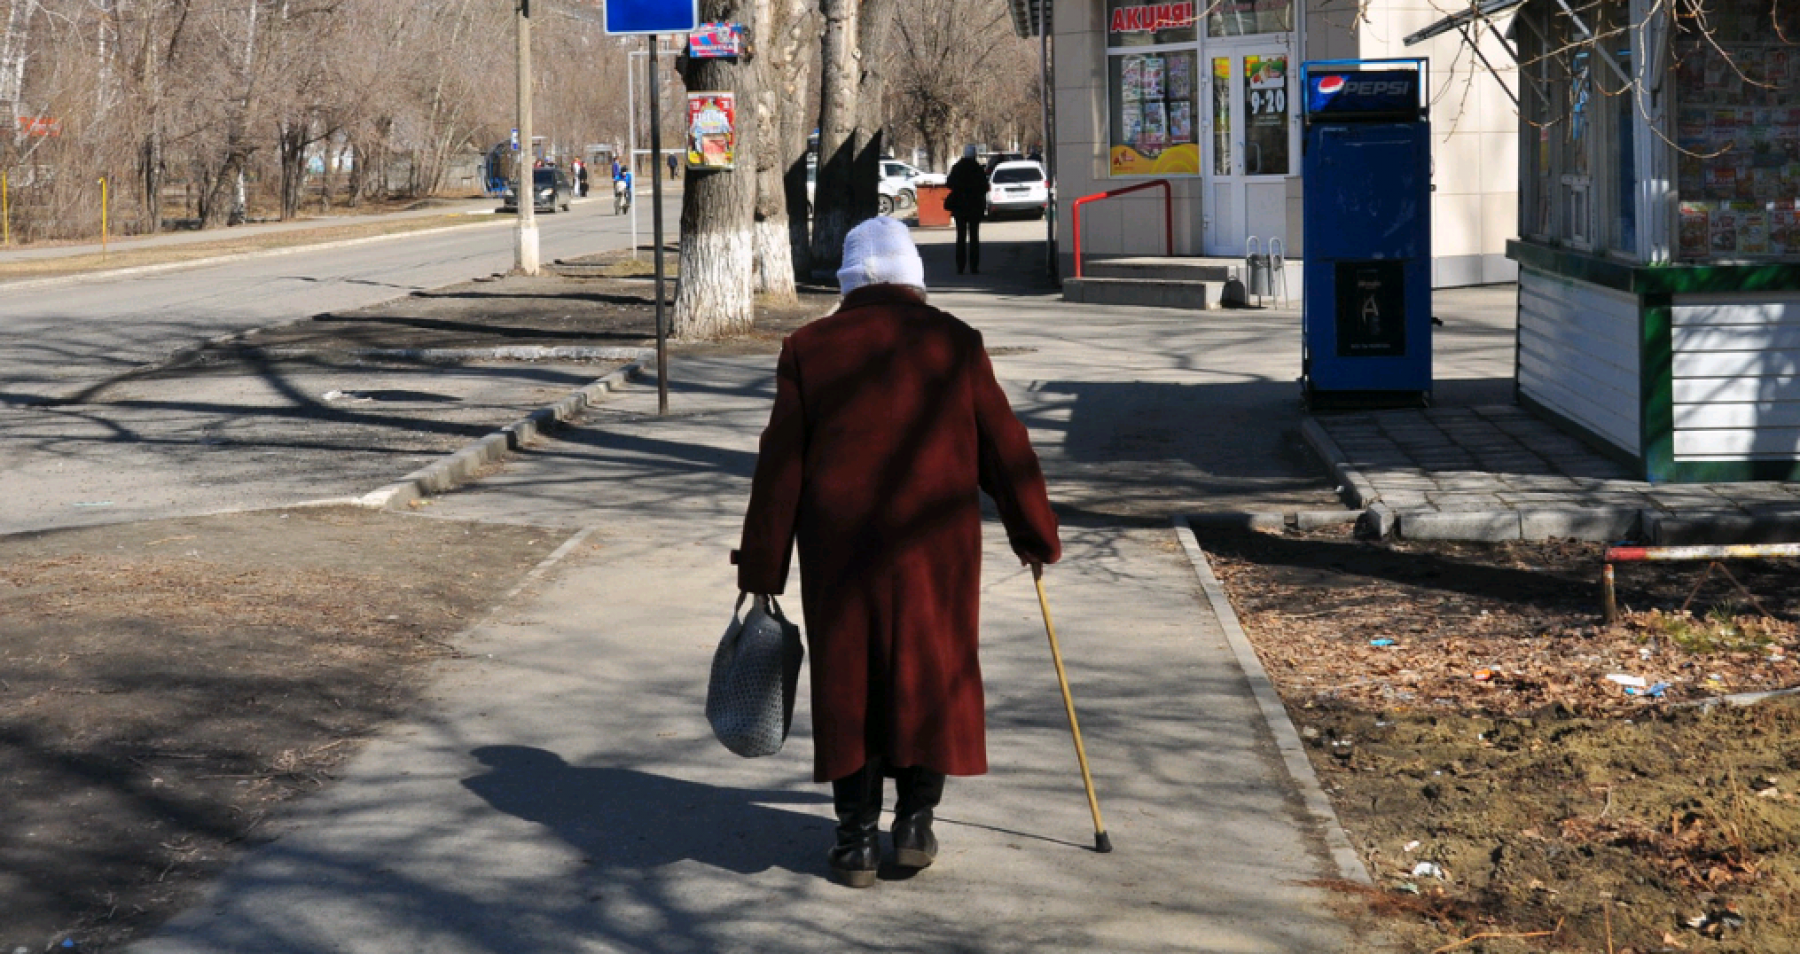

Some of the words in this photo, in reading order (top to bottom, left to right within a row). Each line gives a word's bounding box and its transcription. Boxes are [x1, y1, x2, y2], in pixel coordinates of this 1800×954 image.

[1111, 2, 1192, 33] АКЦИЯ!
[1342, 81, 1410, 96] PEPSI
[1251, 89, 1285, 115] 9-20
